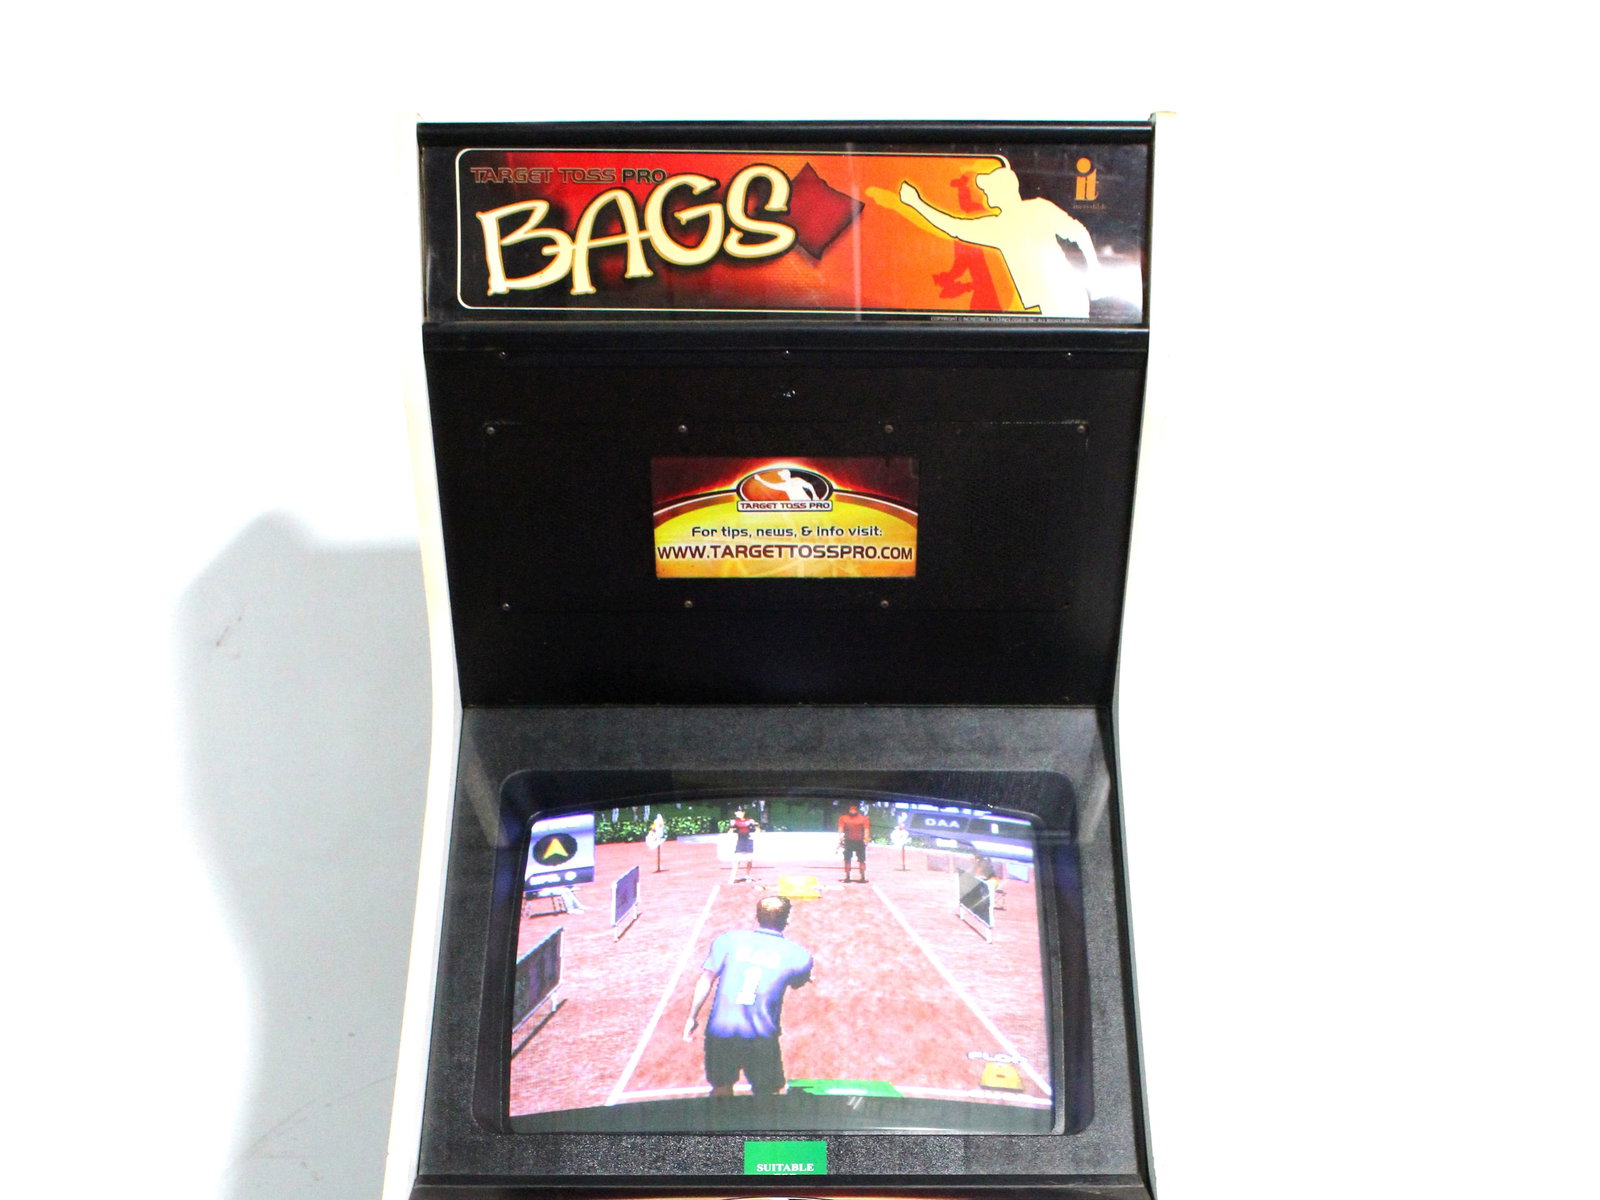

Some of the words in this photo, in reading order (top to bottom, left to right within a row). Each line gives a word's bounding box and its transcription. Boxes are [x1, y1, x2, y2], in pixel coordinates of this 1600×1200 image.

[470, 167, 553, 184] TARGET
[558, 167, 616, 184] TOSS
[621, 168, 667, 184] PRO
[475, 161, 797, 296] BAGS
[739, 501, 779, 510] TARGET
[780, 501, 807, 510] TOSS
[808, 501, 831, 510] PRO
[691, 526, 718, 538] For
[721, 525, 752, 540] tips,
[756, 527, 797, 539] news,
[801, 526, 812, 537] &
[817, 525, 844, 537] info
[848, 525, 883, 537] visit:
[657, 545, 913, 561] WWW.TARGETTOSSPRO.COM
[756, 1163, 815, 1172] SUITABLE
